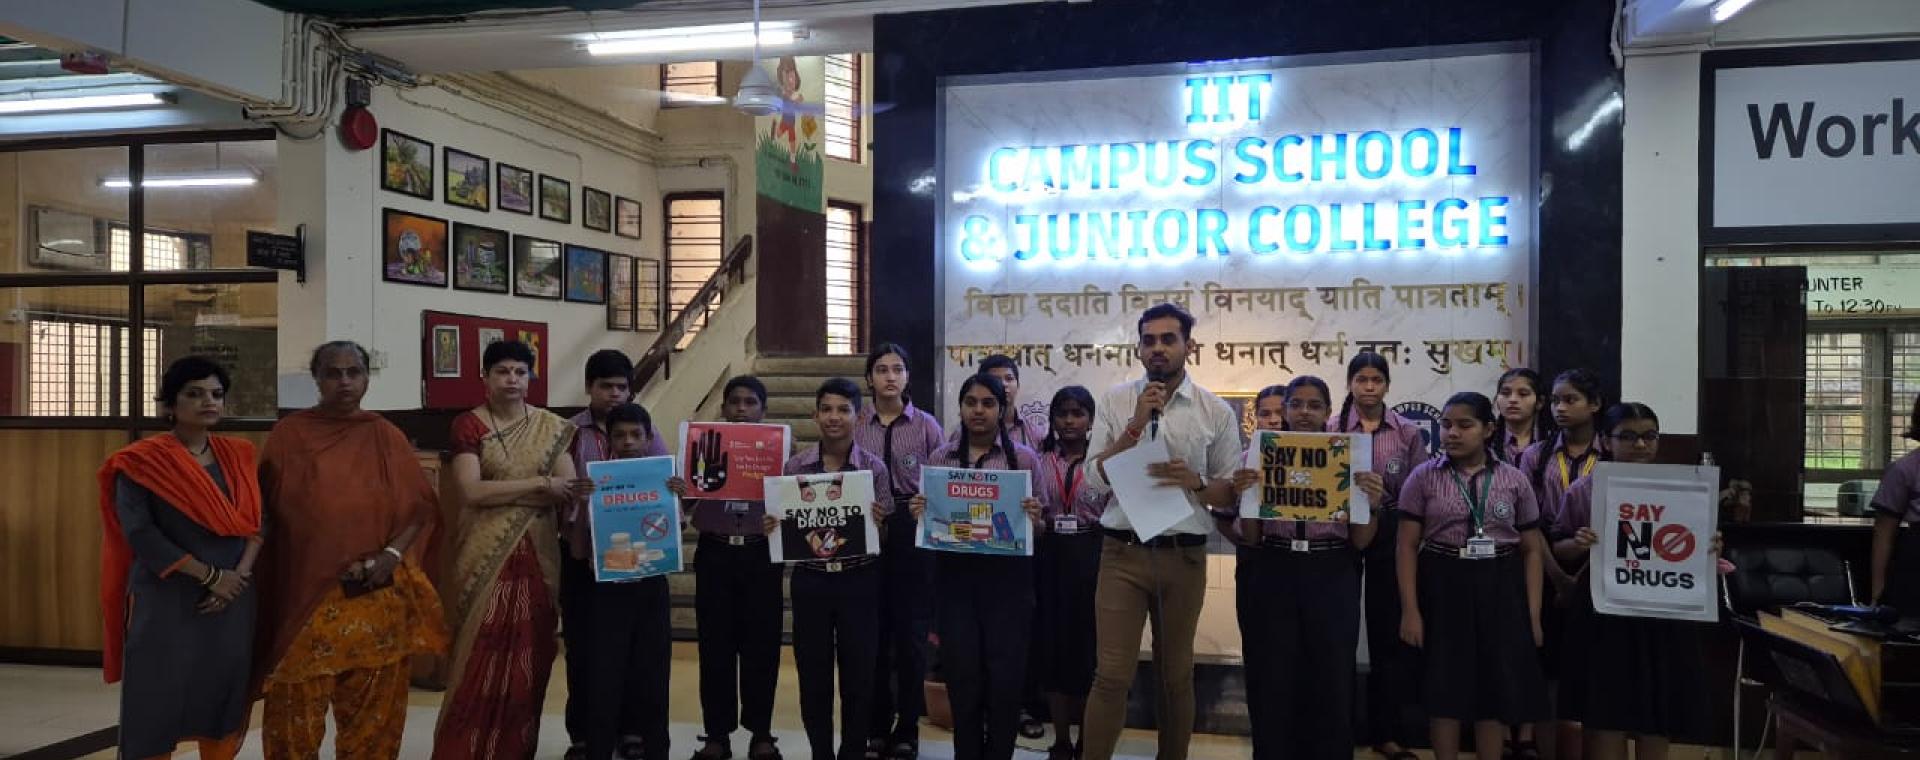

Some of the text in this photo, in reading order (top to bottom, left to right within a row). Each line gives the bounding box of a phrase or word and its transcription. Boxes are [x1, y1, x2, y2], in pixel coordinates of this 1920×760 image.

[1184, 73, 1272, 124] IIT
[1747, 98, 1920, 160] Work
[989, 127, 1477, 192] CAMPUS SCHOOL
[960, 196, 1510, 261] & JUNIOR COLLEGE
[964, 287, 1028, 318] विद्या
[1034, 284, 1112, 317] ददाति
[1316, 278, 1384, 311] याति
[1263, 446, 1327, 468] SAY NO
[947, 471, 965, 480] SAY
[1262, 466, 1286, 486] TO
[602, 490, 660, 506] DRUGS
[952, 485, 994, 498] DRUGS
[1263, 486, 1328, 508] DRUGS
[785, 505, 861, 519] SAY NO TO
[798, 516, 847, 528] DRUGS
[1619, 503, 1665, 522] SAY
[1625, 560, 1640, 569] TO
[1615, 567, 1695, 590] DRUGS
